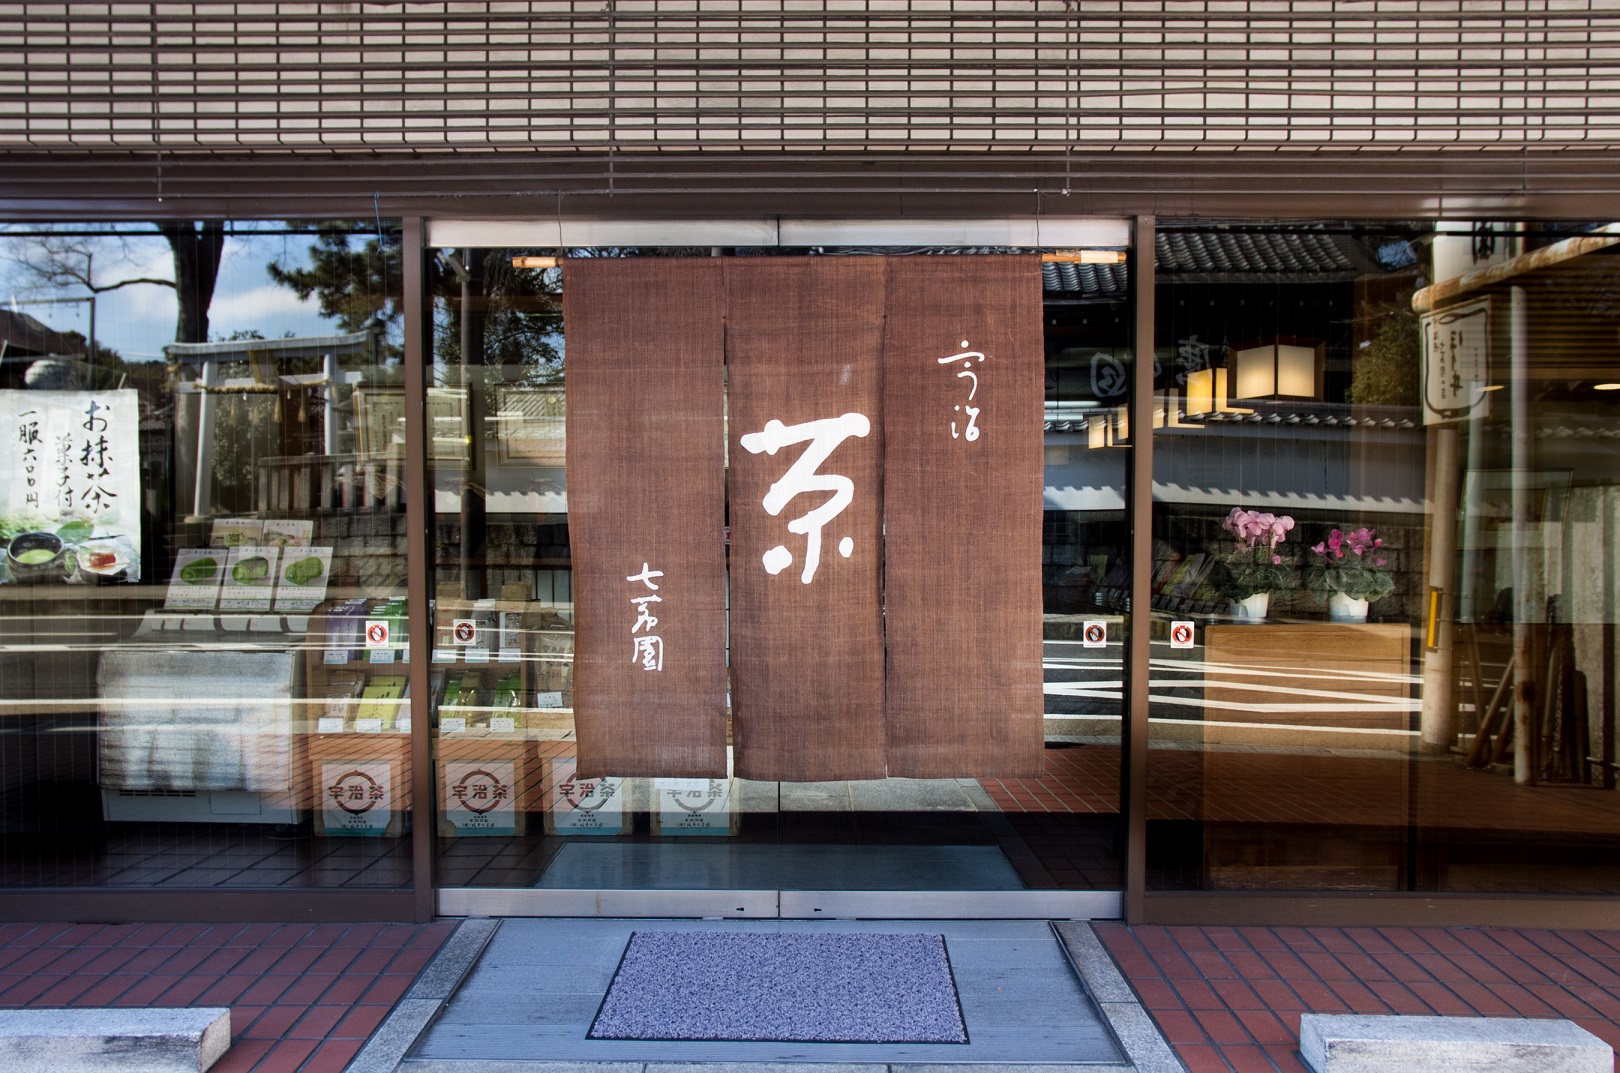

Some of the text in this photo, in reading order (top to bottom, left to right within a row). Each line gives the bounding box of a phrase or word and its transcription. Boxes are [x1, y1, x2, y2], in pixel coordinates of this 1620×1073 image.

[938, 340, 985, 442] 宇治
[55, 432, 73, 508] 菓子付
[79, 400, 118, 514] お抹茶
[740, 412, 871, 585] 茶
[328, 785, 385, 800] 宇治茶
[452, 784, 508, 800] 宇治茶
[559, 783, 616, 798] 宇治茶
